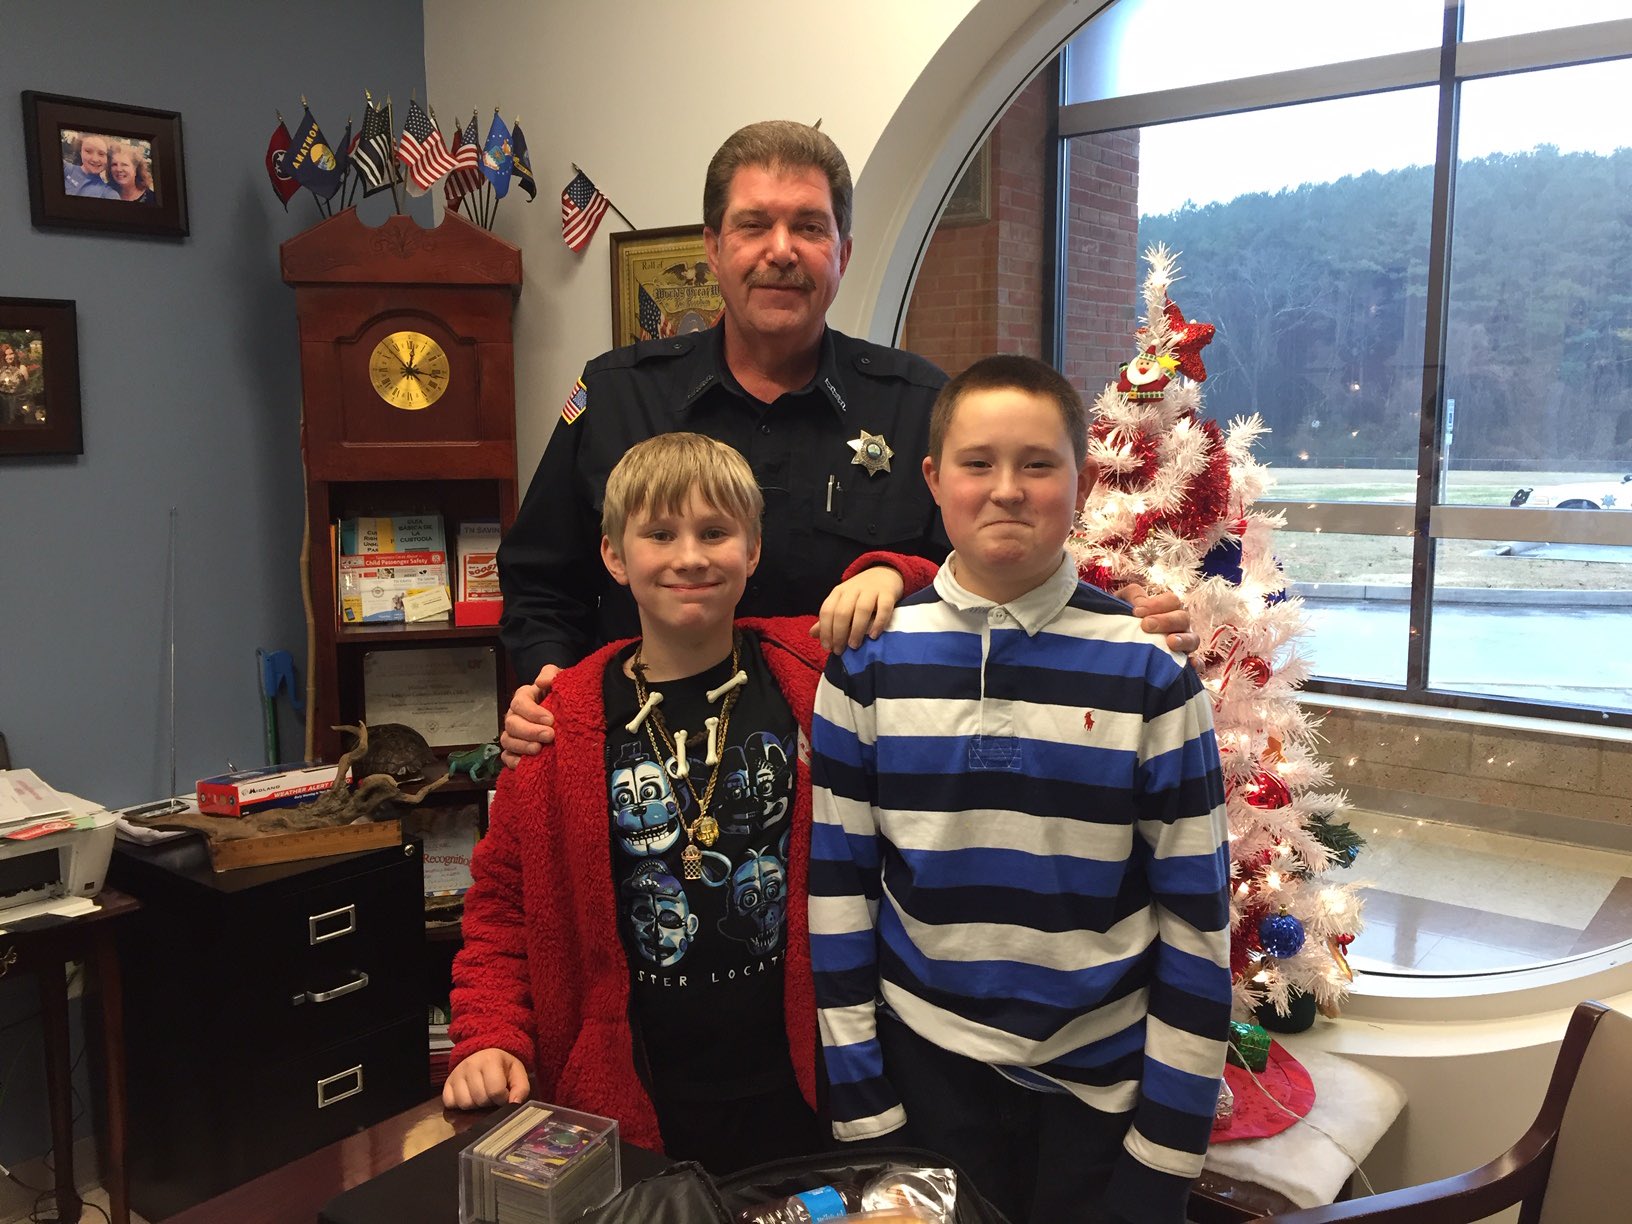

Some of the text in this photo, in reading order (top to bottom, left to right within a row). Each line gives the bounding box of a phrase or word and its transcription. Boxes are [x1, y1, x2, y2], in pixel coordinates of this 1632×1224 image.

[686, 285, 710, 298] Great
[365, 557, 429, 567] Child Passenger Safety
[248, 784, 281, 795] MIDLAND
[273, 788, 307, 798] WEATHER
[307, 783, 329, 792] ALERT
[423, 853, 471, 867] Recognitio
[637, 970, 688, 987] STER
